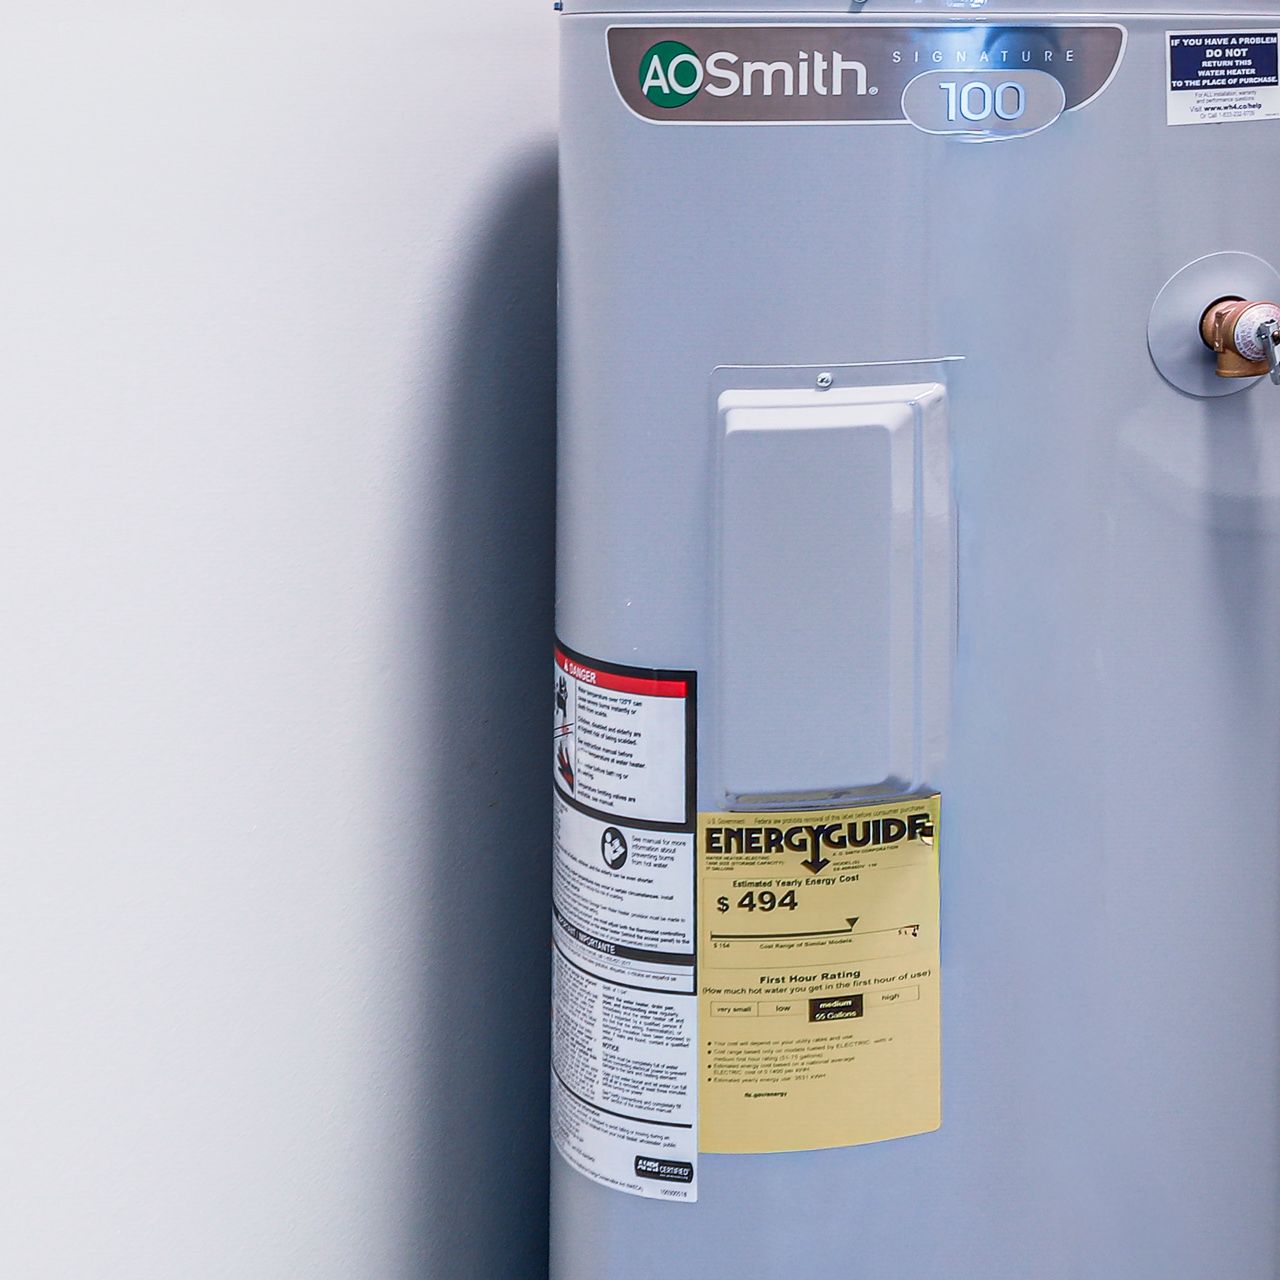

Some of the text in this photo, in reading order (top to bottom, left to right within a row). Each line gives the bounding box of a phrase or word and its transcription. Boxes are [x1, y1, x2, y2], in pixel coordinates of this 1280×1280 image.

[1182, 38, 1202, 46] YOU
[892, 49, 1076, 64] SIGNATURE
[1205, 48, 1248, 58] DO NOT
[1198, 68, 1256, 77] WATER HEATER
[1202, 78, 1227, 86] PLACE
[1239, 76, 1278, 84] PURCHASE.
[939, 81, 1027, 121] 100
[569, 663, 597, 685] DANGER
[732, 873, 860, 889] Estimated Yearly Energy Cost
[716, 889, 799, 914] $ 494
[804, 940, 827, 948] Similar
[702, 986, 722, 995] (How
[723, 986, 746, 995] much
[748, 986, 762, 994] hot
[789, 986, 807, 995] you
[808, 984, 823, 993] get
[835, 981, 850, 989] the
[853, 979, 872, 987] first
[873, 975, 898, 984] hour
[898, 972, 909, 980] of
[910, 969, 932, 979] use)
[759, 970, 861, 984] First Hour Rating
[881, 993, 900, 1001] high
[819, 999, 852, 1009] medium
[717, 1006, 732, 1014] very
[827, 1009, 857, 1019] Gallons
